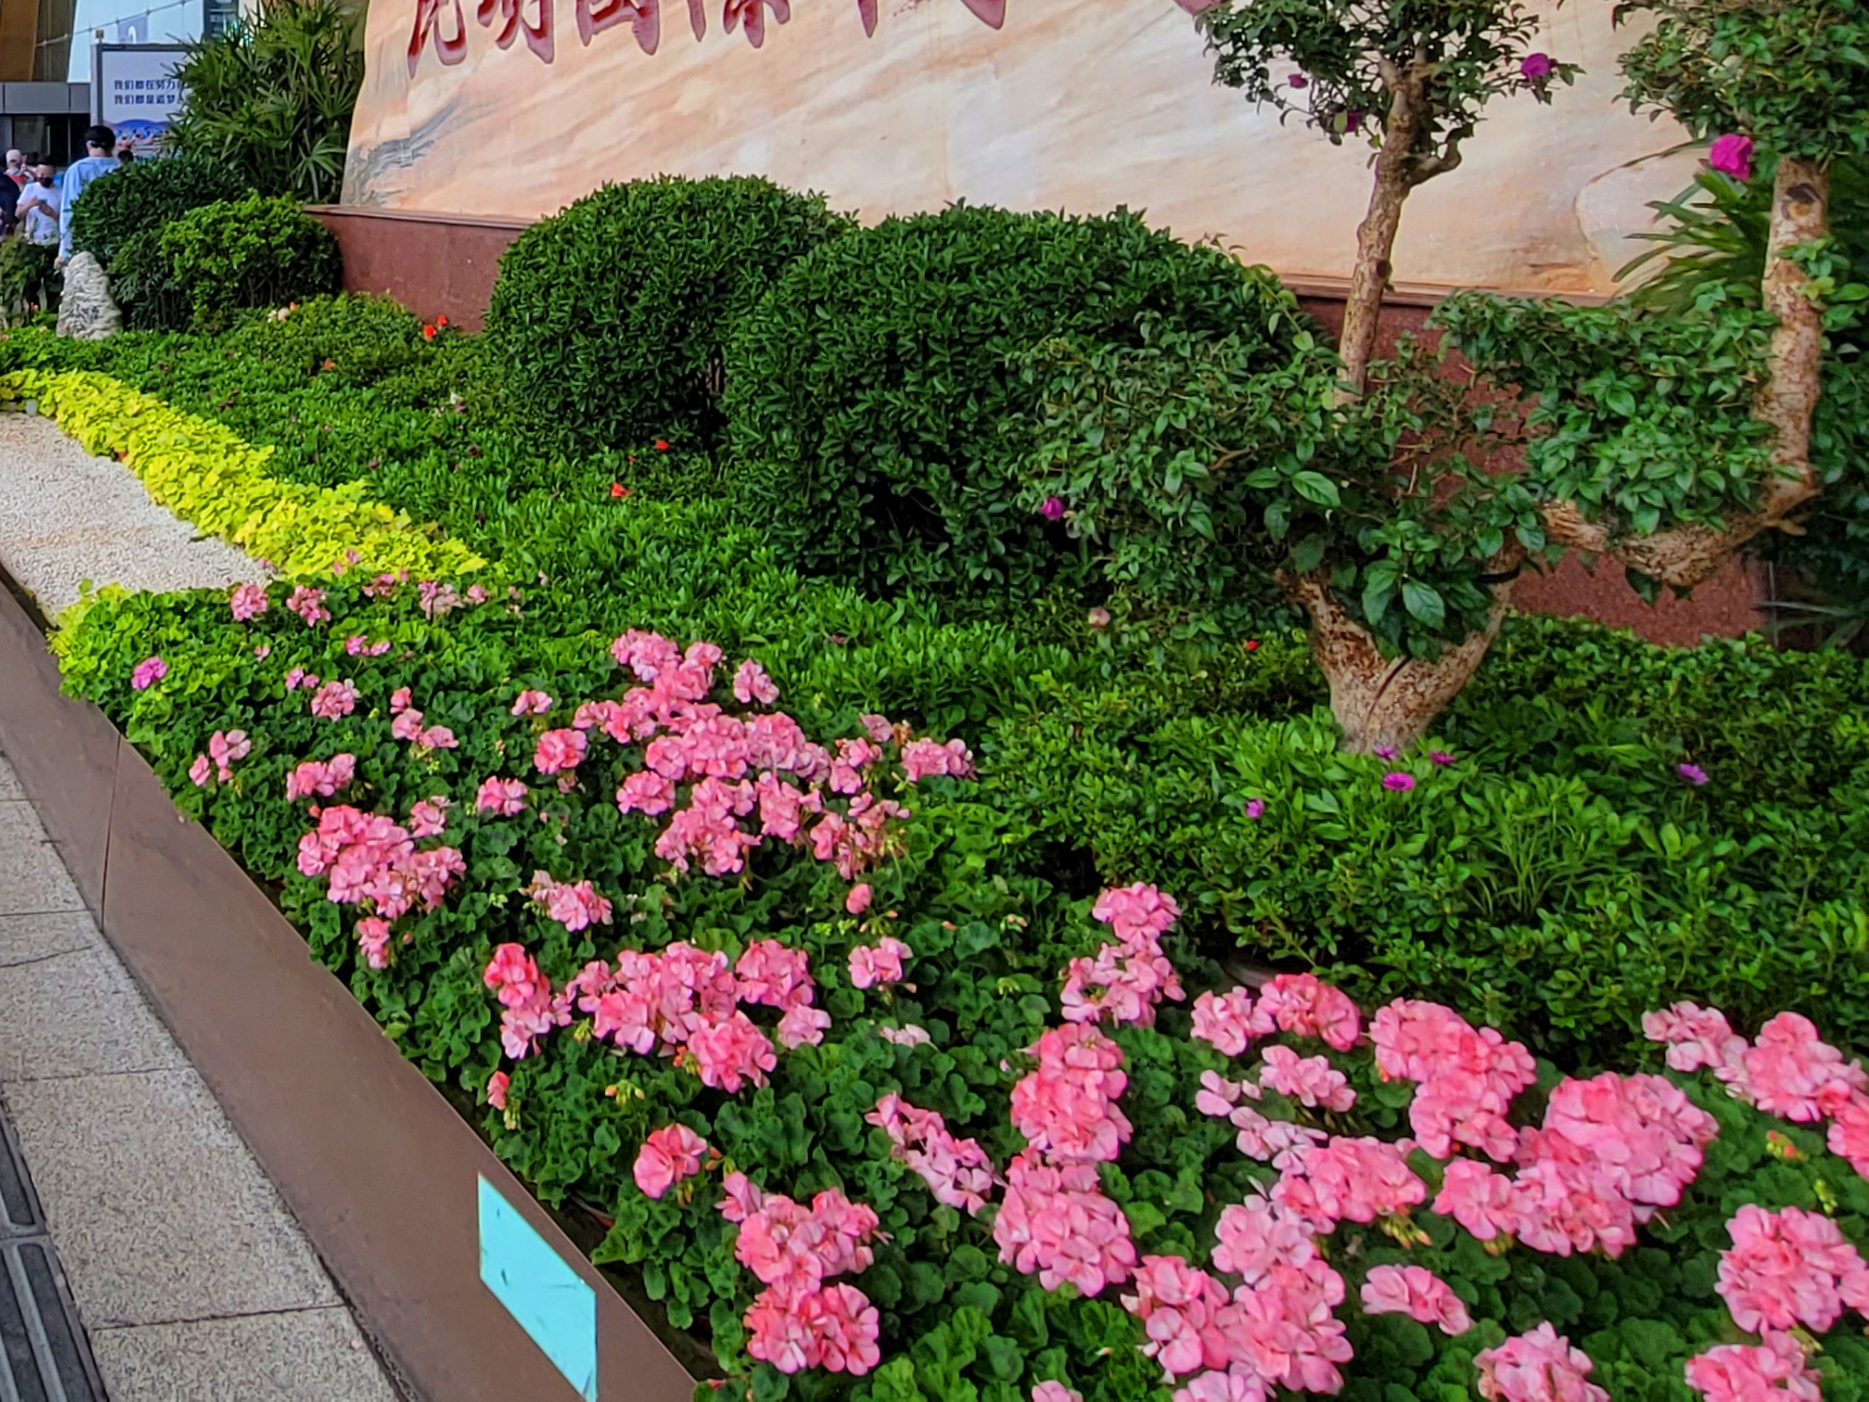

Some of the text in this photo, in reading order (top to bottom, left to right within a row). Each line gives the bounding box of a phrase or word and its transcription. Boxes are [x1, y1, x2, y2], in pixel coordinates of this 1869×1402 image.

[114, 79, 180, 91] 我们都在努力
